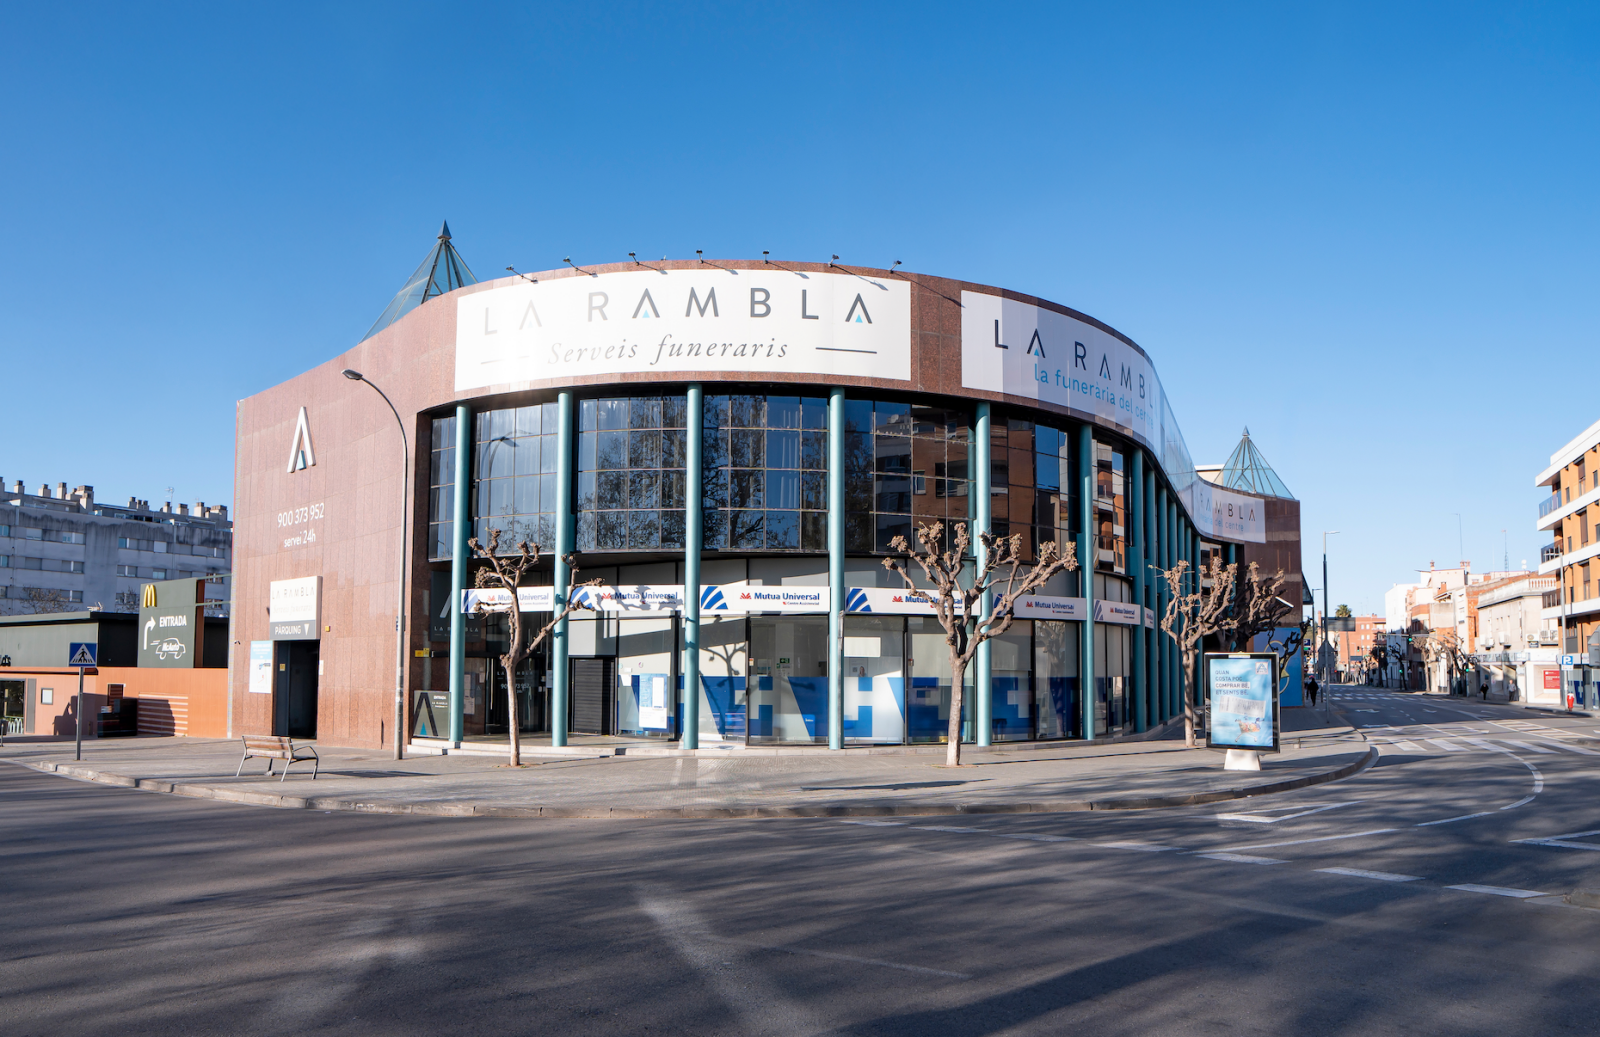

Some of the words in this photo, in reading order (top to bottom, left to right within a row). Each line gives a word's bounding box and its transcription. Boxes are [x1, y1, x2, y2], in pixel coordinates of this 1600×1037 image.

[485, 299, 543, 336] LA
[587, 286, 873, 324] RAMBLA
[994, 319, 1046, 359] LA
[548, 338, 638, 365] Serveis
[649, 333, 788, 366] funeraris
[1034, 363, 1049, 384] la
[1055, 369, 1116, 406] funerària
[1119, 393, 1133, 414] del
[277, 512, 294, 528] 900
[294, 506, 309, 525] 373
[309, 502, 325, 521] 952
[284, 531, 302, 548] servei
[302, 528, 316, 545] 24h
[284, 586, 315, 598] RAMBLA
[519, 592, 549, 601] Universal
[615, 591, 640, 600] Mutua
[641, 591, 678, 600] Universal
[754, 592, 781, 600] Mutua
[782, 592, 820, 600] Universal
[1035, 601, 1051, 609] Mutua
[1052, 602, 1075, 610] Universal
[159, 614, 187, 628] ENTRADA
[274, 624, 302, 635] PÀRQUING
[162, 642, 180, 651] McAuto
[1563, 656, 1572, 665] P
